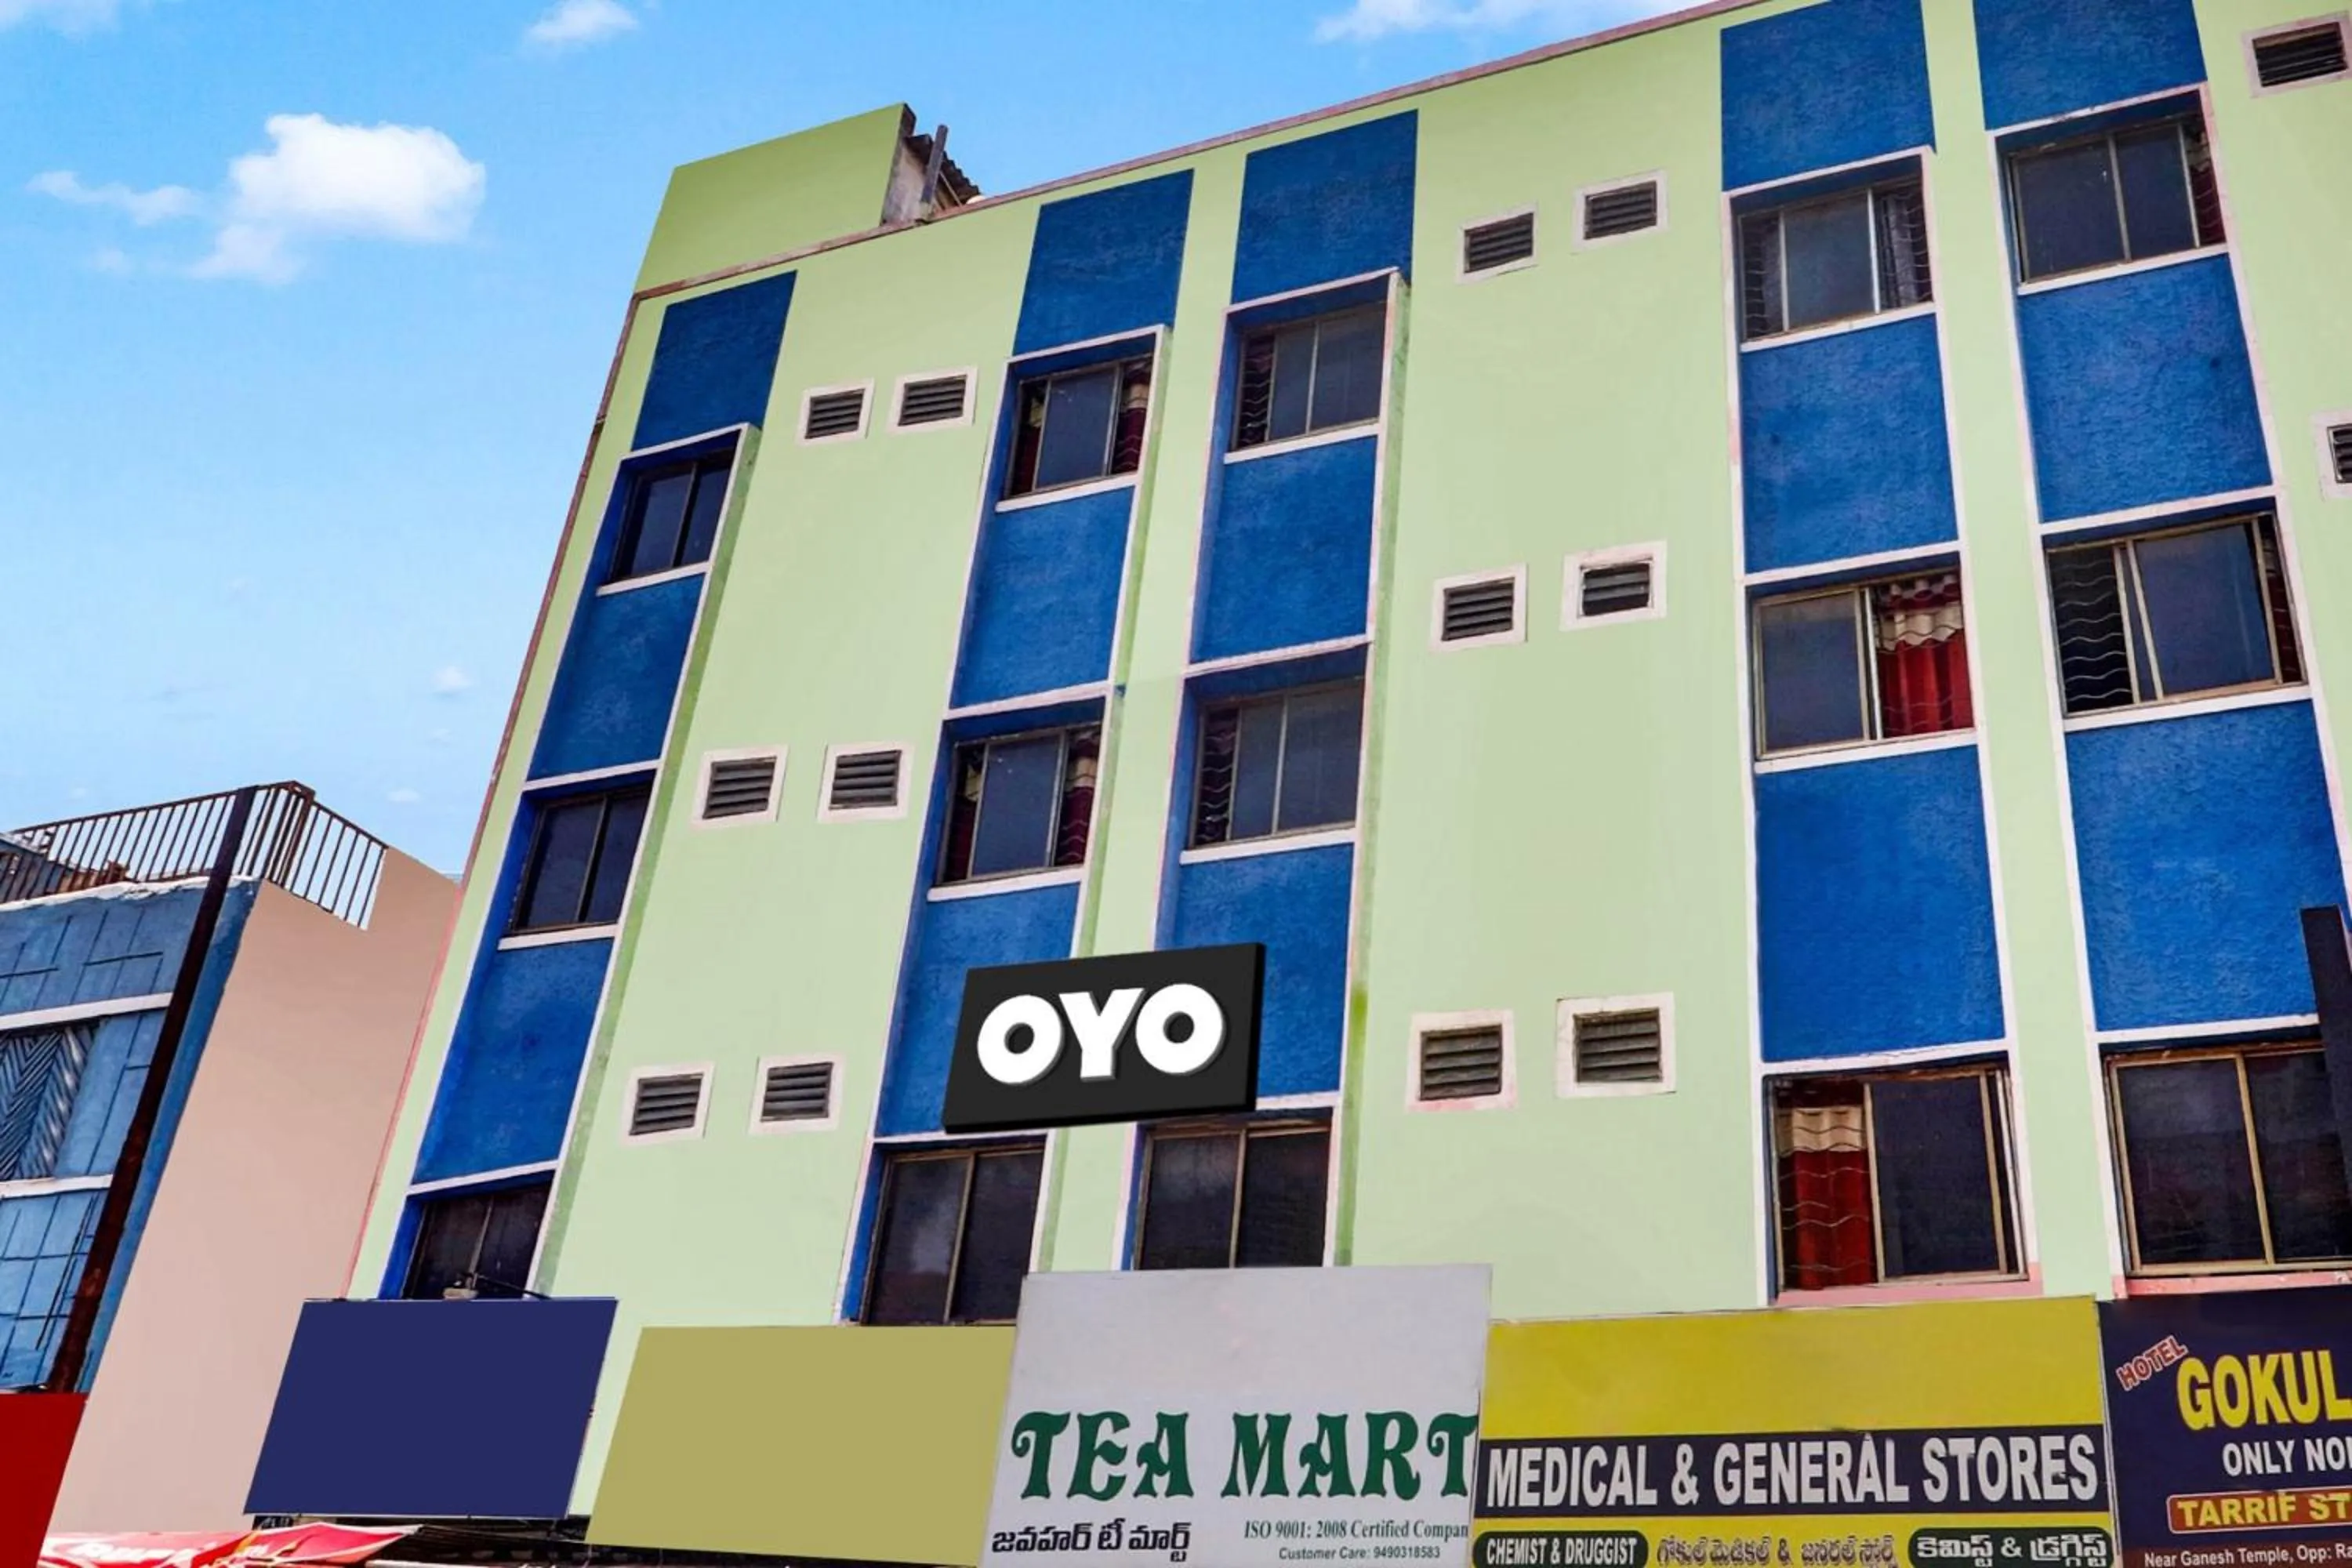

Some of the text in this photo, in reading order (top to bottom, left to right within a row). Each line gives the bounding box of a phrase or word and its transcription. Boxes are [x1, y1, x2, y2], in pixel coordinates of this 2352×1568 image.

[977, 983, 1226, 1085] OYO
[2116, 1335, 2189, 1392] HOTEL
[2176, 1349, 2352, 1431] GOKUL
[1011, 1411, 1479, 1501] TEA MART
[1486, 1434, 2098, 1507] MEDICAL & GENERAL STORES
[2223, 1439, 2295, 1476] ONLY
[2176, 1490, 2296, 1526] TARRIF
[992, 1518, 1191, 1563] జవహర్ టీ మార్ట్
[1244, 1520, 1271, 1539] ISO
[1276, 1520, 1312, 1539] 9001:
[1316, 1520, 1347, 1538] 2008
[1351, 1519, 1409, 1538] Certified
[1279, 1547, 1335, 1559] Customer
[1486, 1537, 1638, 1565] CHEMIST & DRUGGIST
[1777, 1537, 1792, 1566] &
[2001, 1537, 2023, 1558] &
[2144, 1552, 2177, 1567] Near
[2181, 1549, 2234, 1566] Ganesh
[2238, 1546, 2294, 1566] Temple,
[2296, 1544, 2332, 1564] Opp:
